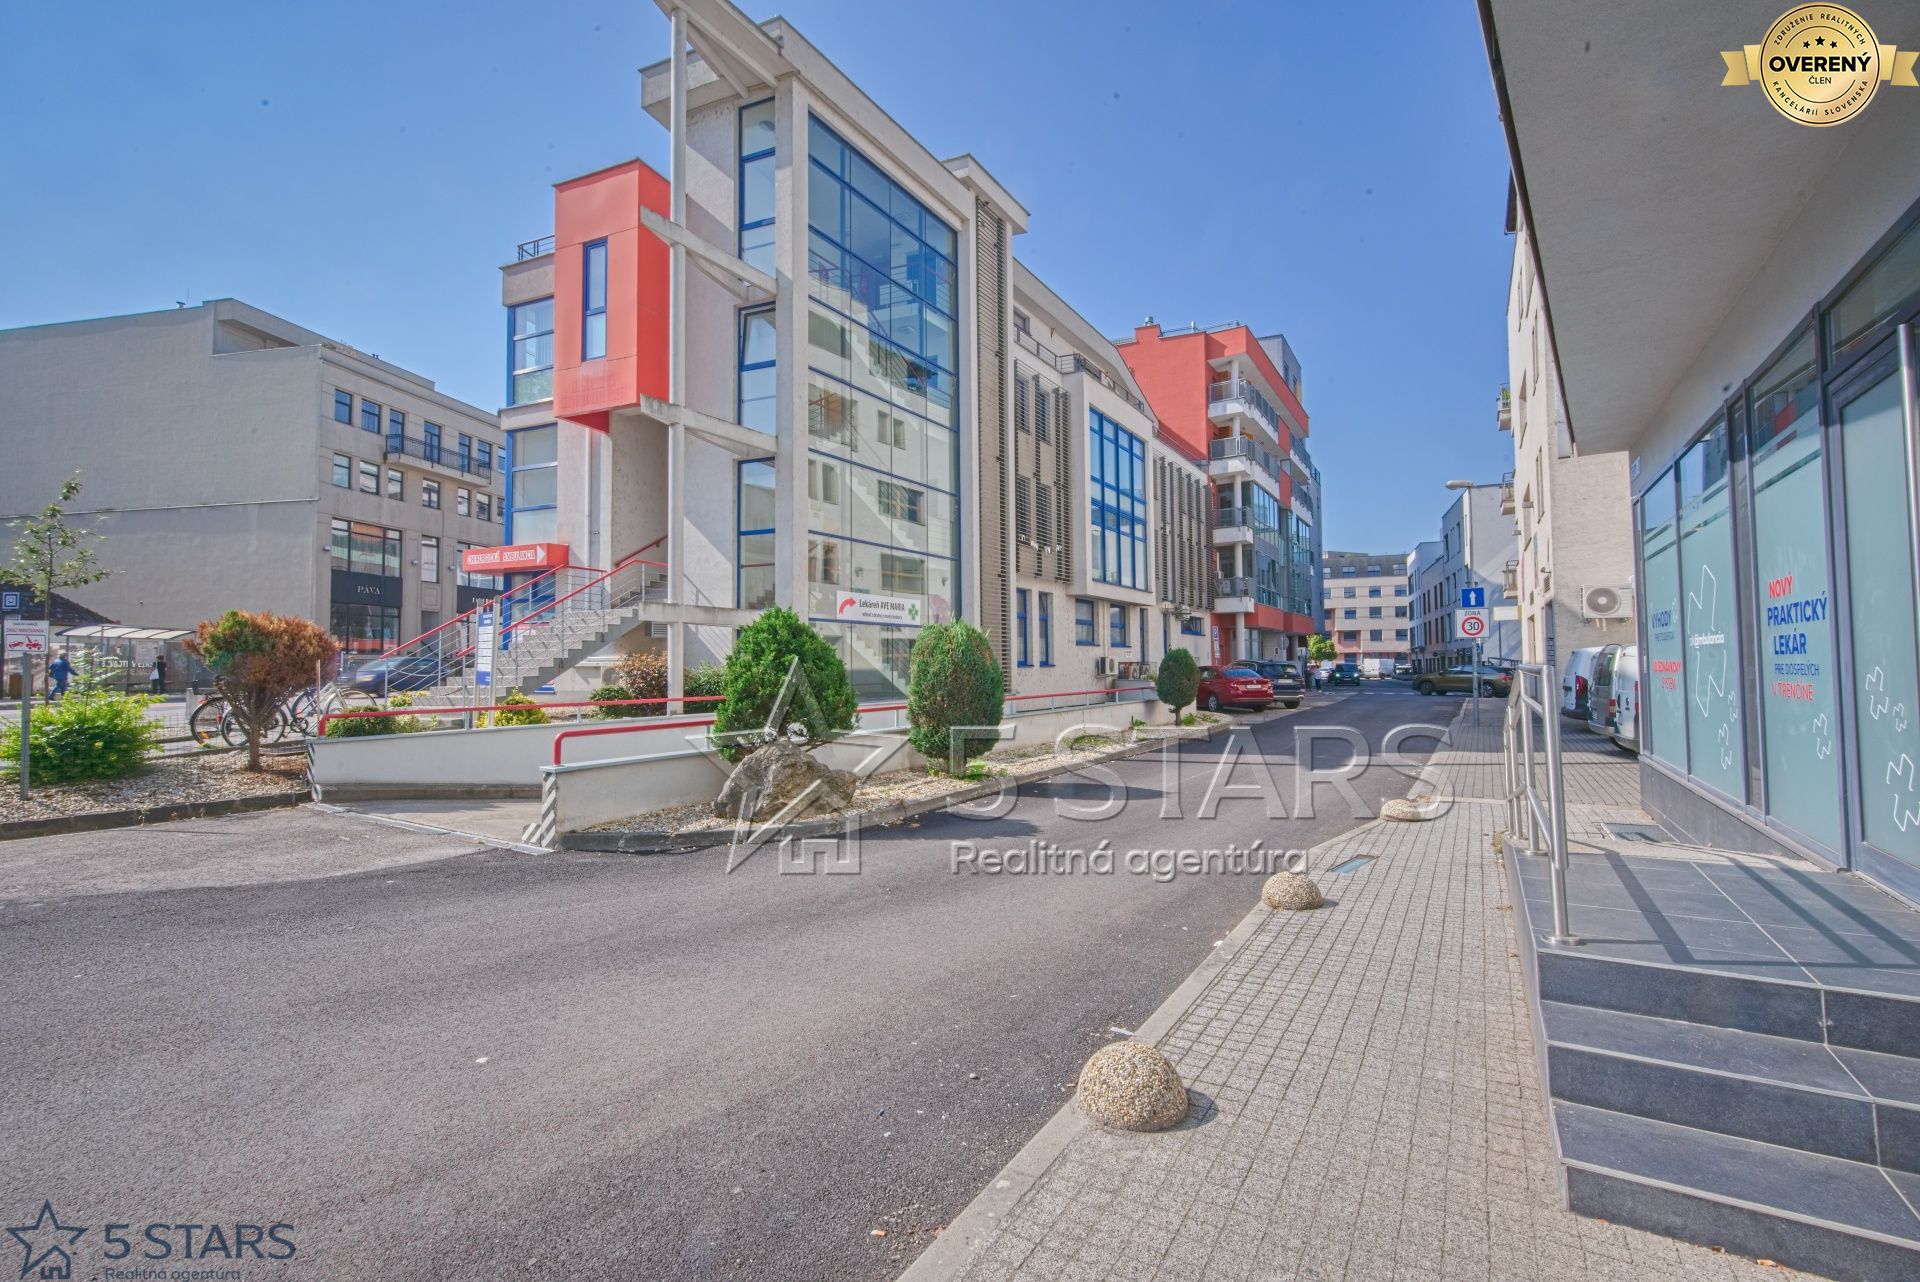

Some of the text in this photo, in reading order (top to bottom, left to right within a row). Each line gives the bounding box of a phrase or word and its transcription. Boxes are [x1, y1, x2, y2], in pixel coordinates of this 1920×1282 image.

[357, 584, 381, 595] PÁVA
[1769, 571, 1793, 598] NOVÝ
[859, 599, 905, 611] Lekáreň AVE MARIA
[1767, 590, 1828, 627] PRAKTICKÝ
[1466, 621, 1480, 631] 30
[1773, 628, 1807, 655] LEKÁR
[1775, 660, 1820, 676] PRE DOSPELÝCH
[1772, 680, 1815, 701] V TRENČÍNE
